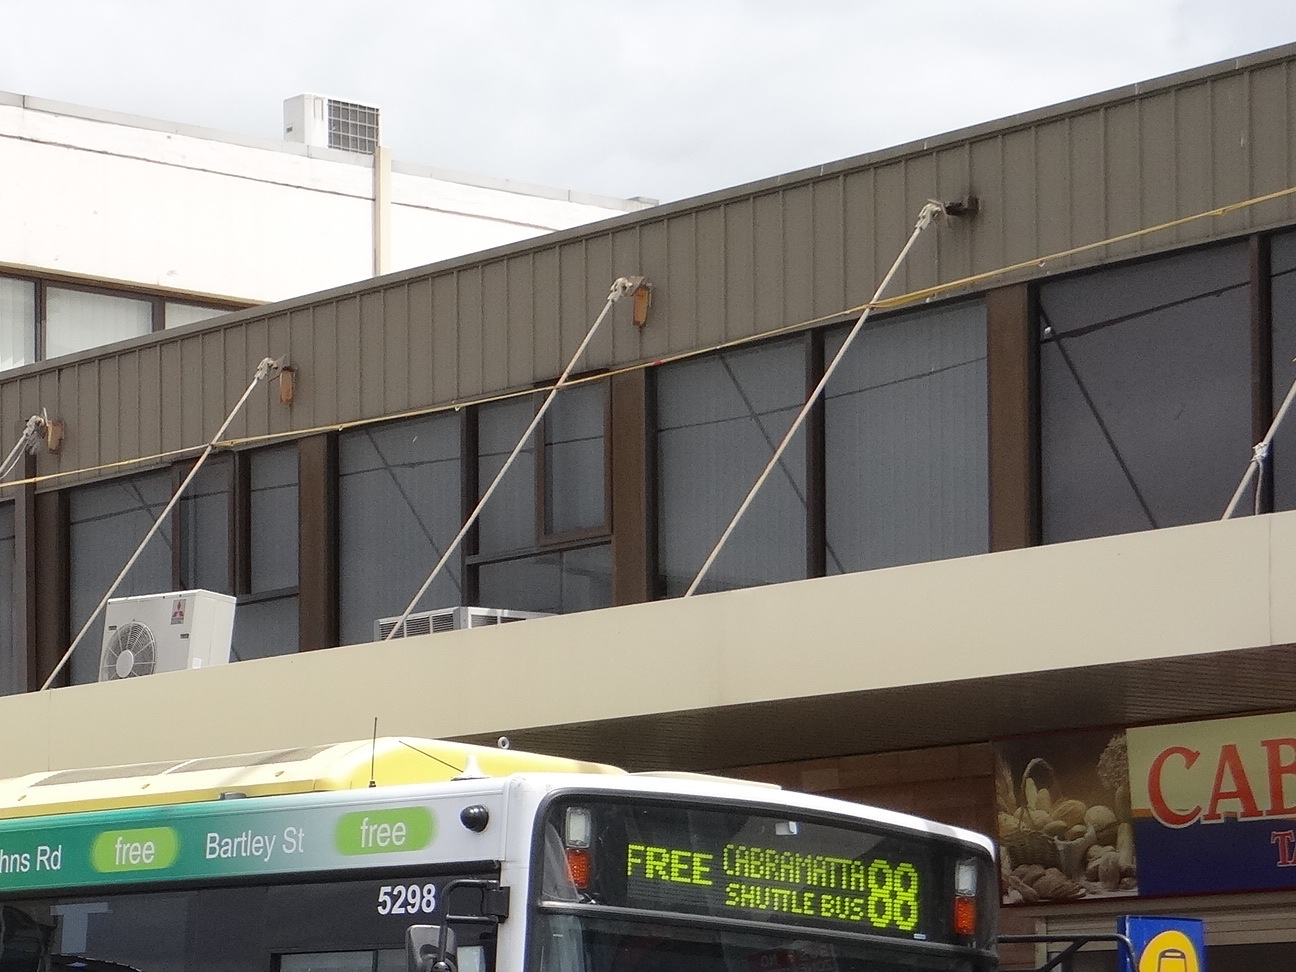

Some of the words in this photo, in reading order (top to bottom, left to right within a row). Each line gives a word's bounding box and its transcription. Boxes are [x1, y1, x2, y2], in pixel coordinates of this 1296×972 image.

[114, 836, 155, 865] free
[205, 829, 276, 862] Bartley
[282, 826, 305, 854] St
[360, 817, 407, 848] free
[36, 845, 62, 871] Rd
[626, 844, 714, 887] FREE
[722, 843, 865, 892] CABRAMATTA
[377, 883, 436, 915] 5298
[724, 883, 815, 917] SHUTTLE
[820, 894, 864, 922] BUS
[867, 858, 919, 931] 88
